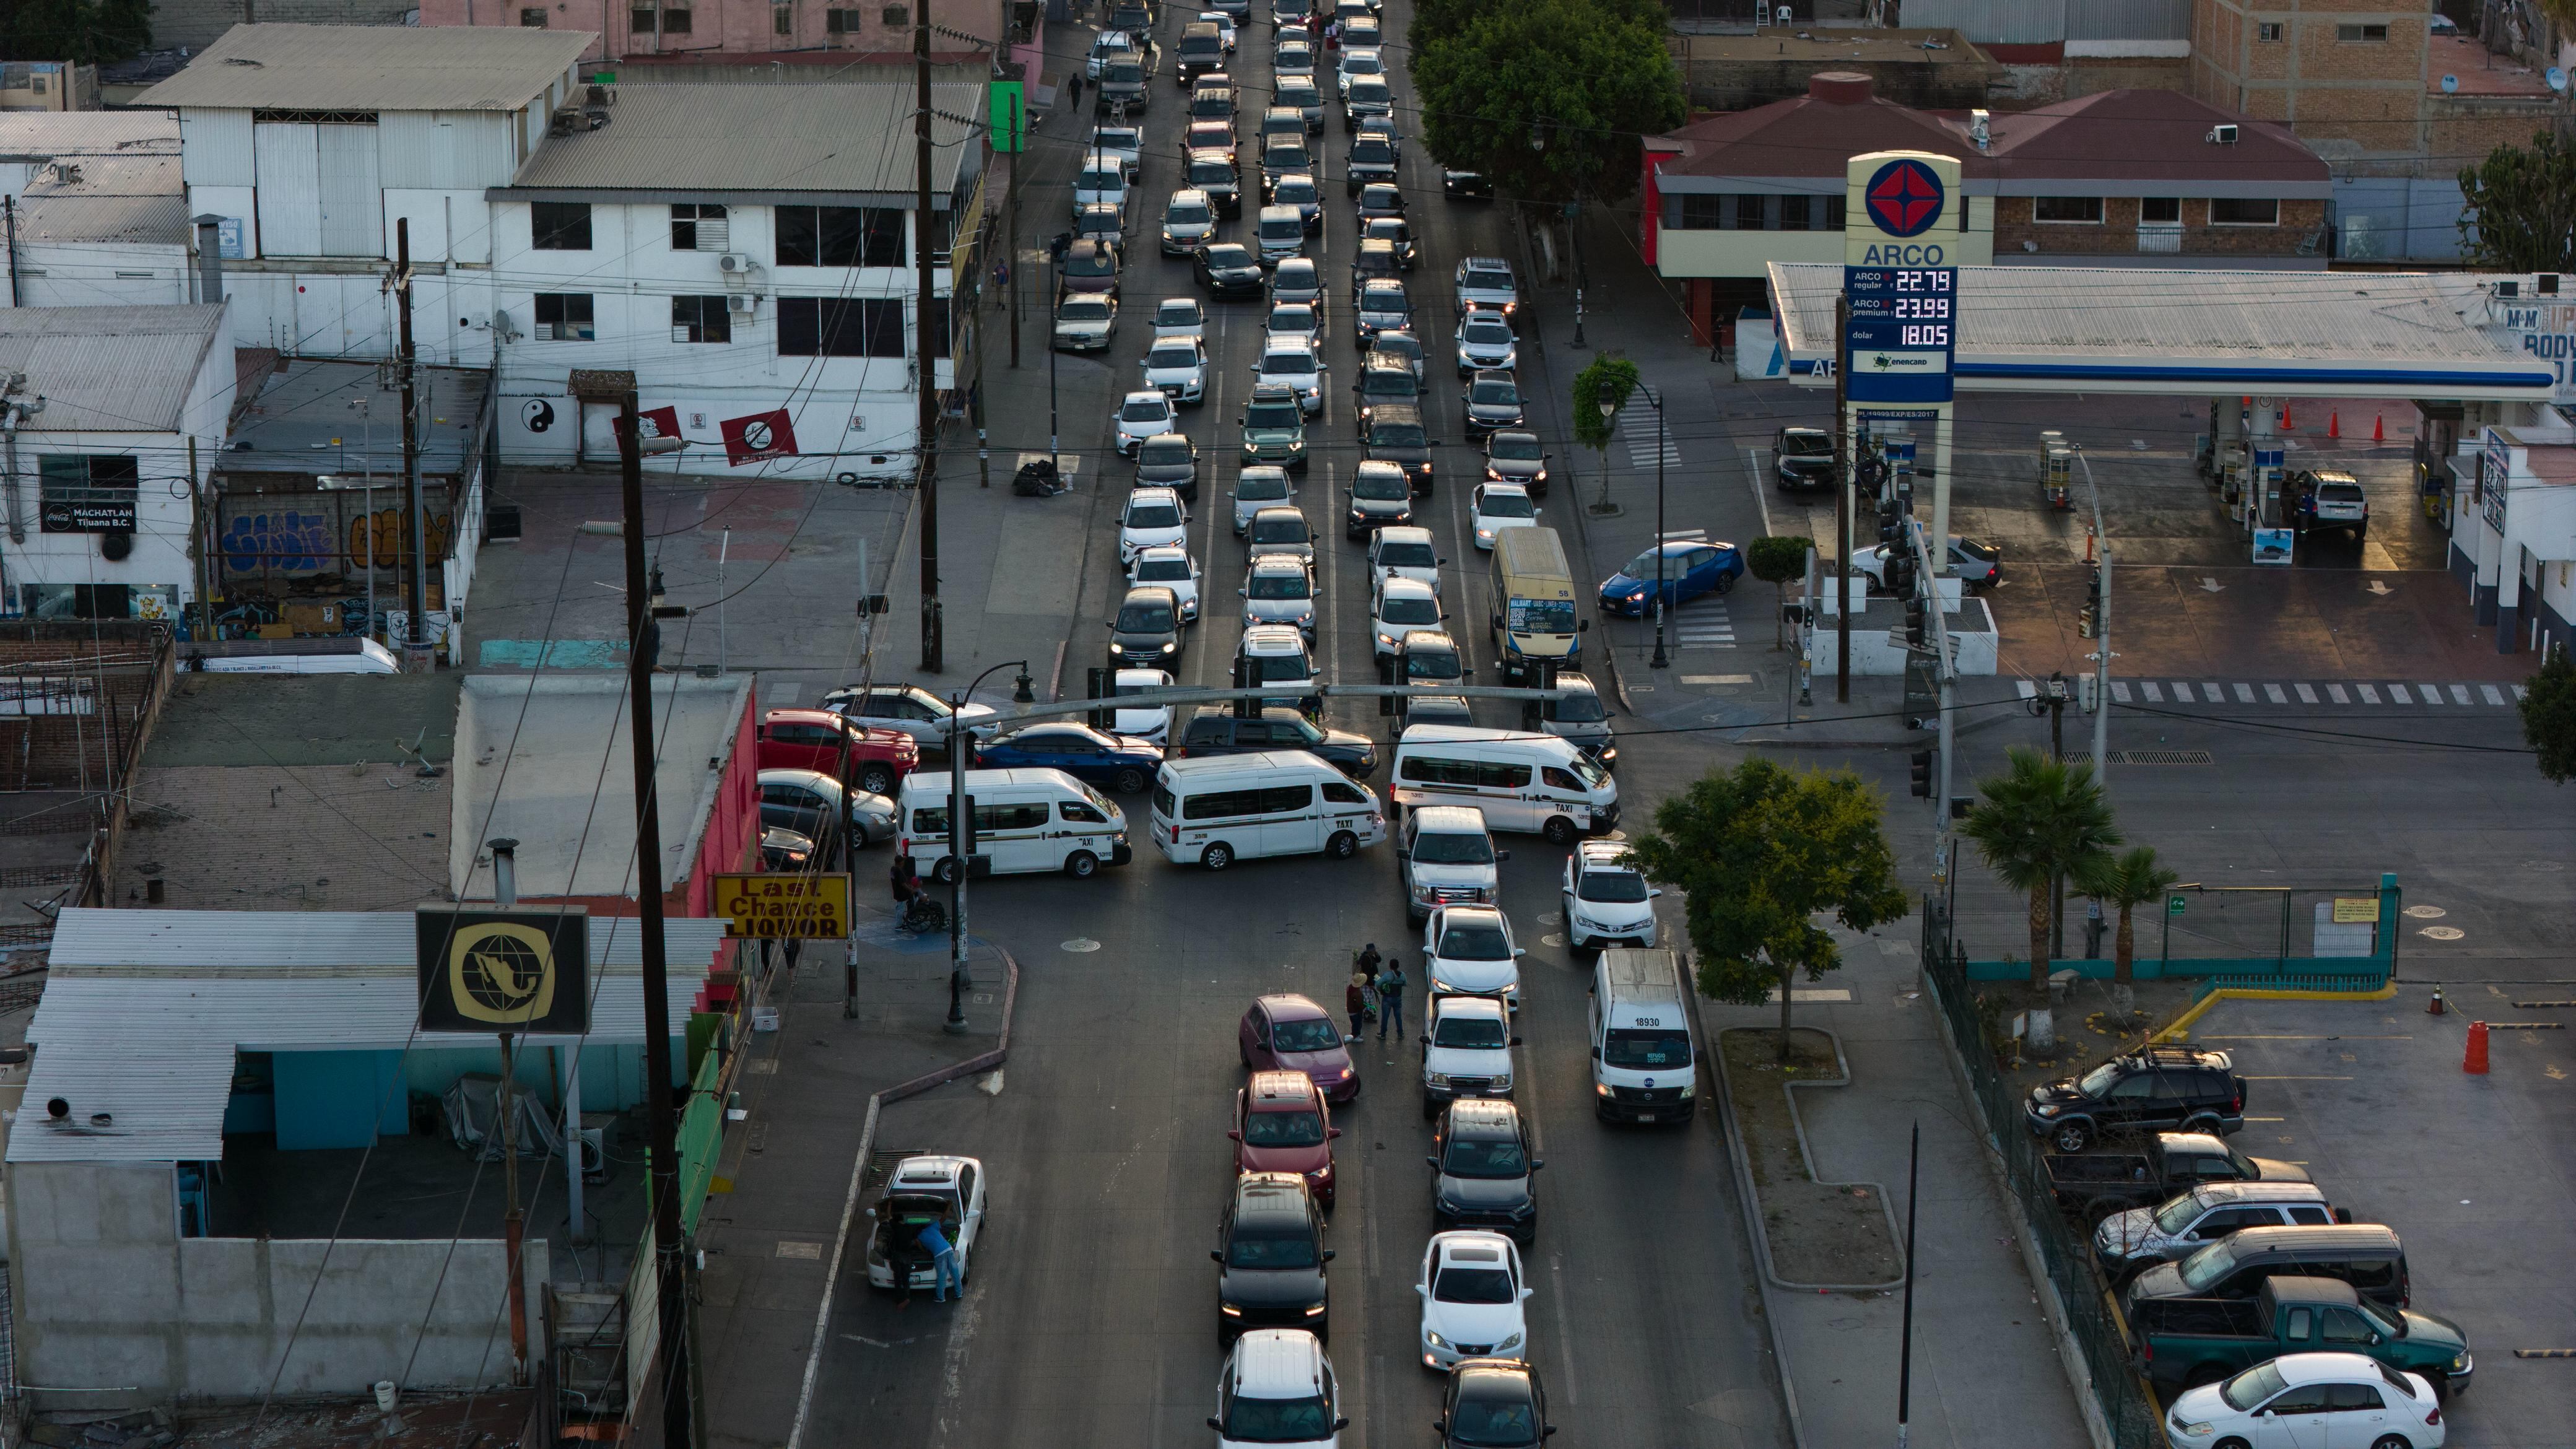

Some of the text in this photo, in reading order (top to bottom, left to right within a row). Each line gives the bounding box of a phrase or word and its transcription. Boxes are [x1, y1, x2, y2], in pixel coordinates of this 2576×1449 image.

[1863, 244, 1944, 266] ARCO
[1854, 282, 1882, 290] regular
[1897, 271, 1950, 291] 22.79
[1854, 300, 1880, 308] ARCO
[1895, 298, 1948, 318] 23.99
[1902, 325, 1947, 345] 18.05
[74, 509, 133, 517] MACHATLAN
[1510, 599, 1531, 607] WALMART
[1556, 804, 1573, 813] TAXI
[1336, 819, 1353, 829] TAXI
[741, 879, 822, 897] Last
[729, 897, 835, 916] Chance
[726, 918, 838, 936] LIQUOR
[1635, 1017, 1660, 1027] 18930
